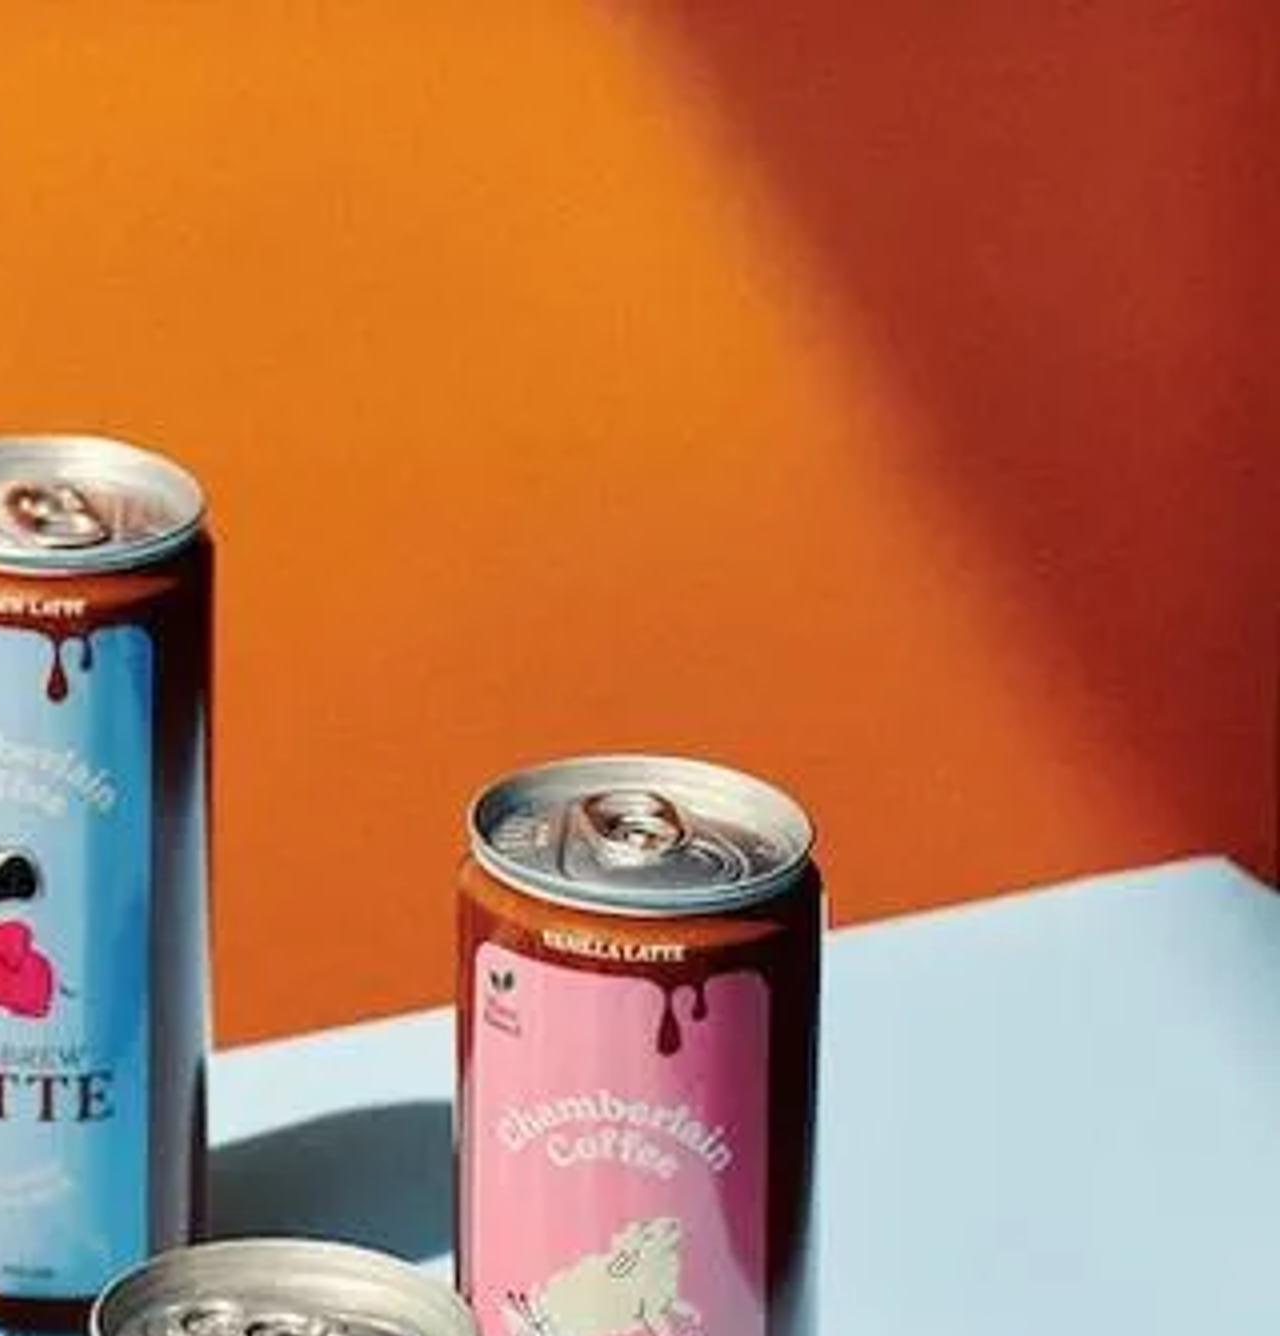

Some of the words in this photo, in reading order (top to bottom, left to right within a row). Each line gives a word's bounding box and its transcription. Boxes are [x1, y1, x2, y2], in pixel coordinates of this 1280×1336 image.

[623, 942, 686, 963] LATTE
[496, 1089, 736, 1172] Chamberlain
[548, 1127, 680, 1179] Coffee
